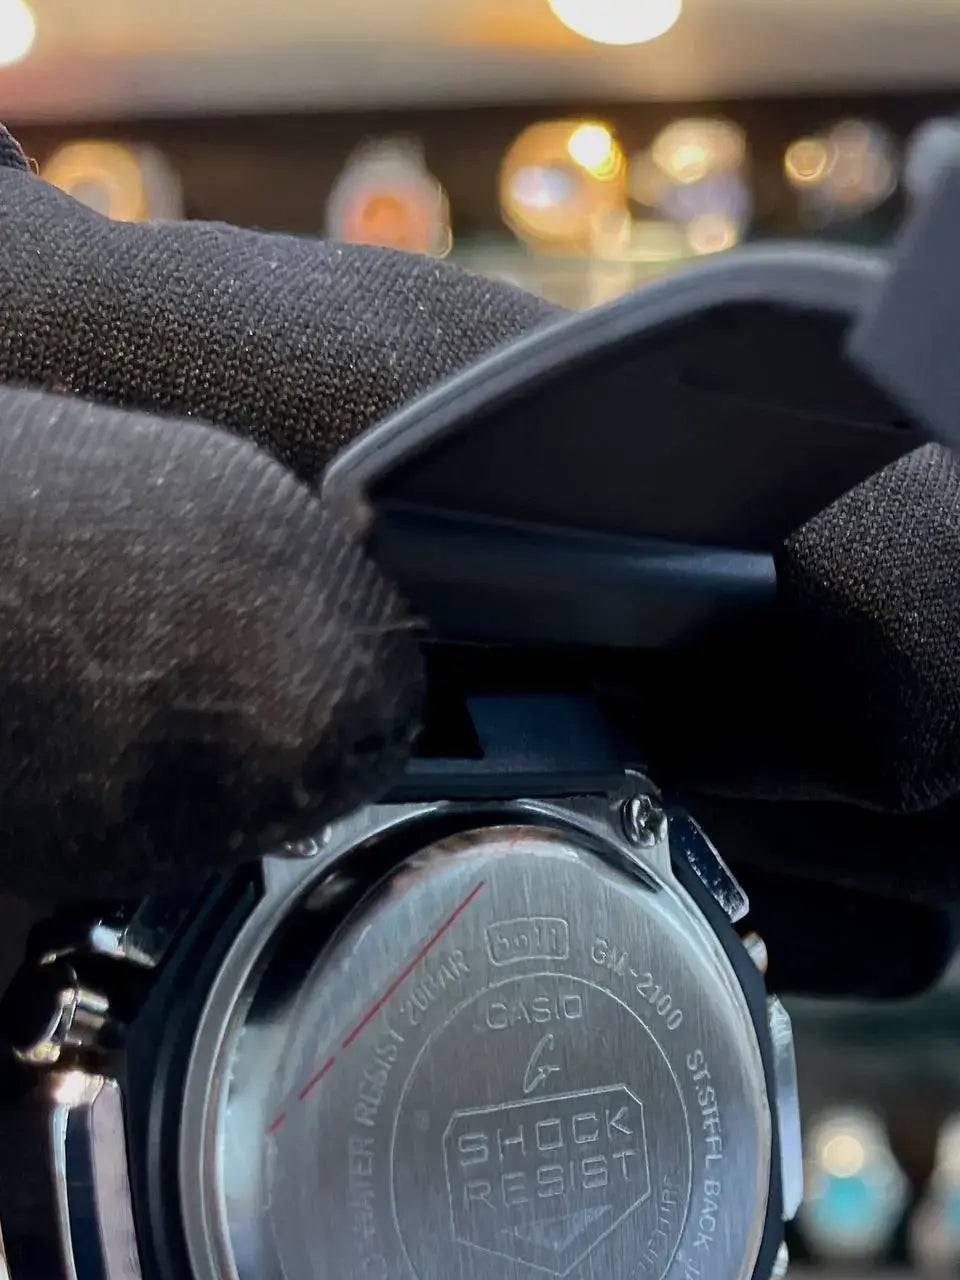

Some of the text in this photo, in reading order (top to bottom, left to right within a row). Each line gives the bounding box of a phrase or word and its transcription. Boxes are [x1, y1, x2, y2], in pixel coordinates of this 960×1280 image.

[486, 994, 582, 1029] CASIO
[591, 937, 682, 1030] GM-2100
[458, 1105, 633, 1167] SHOCK
[464, 1150, 638, 1211] RESIST
[693, 1179, 721, 1251] BACK
